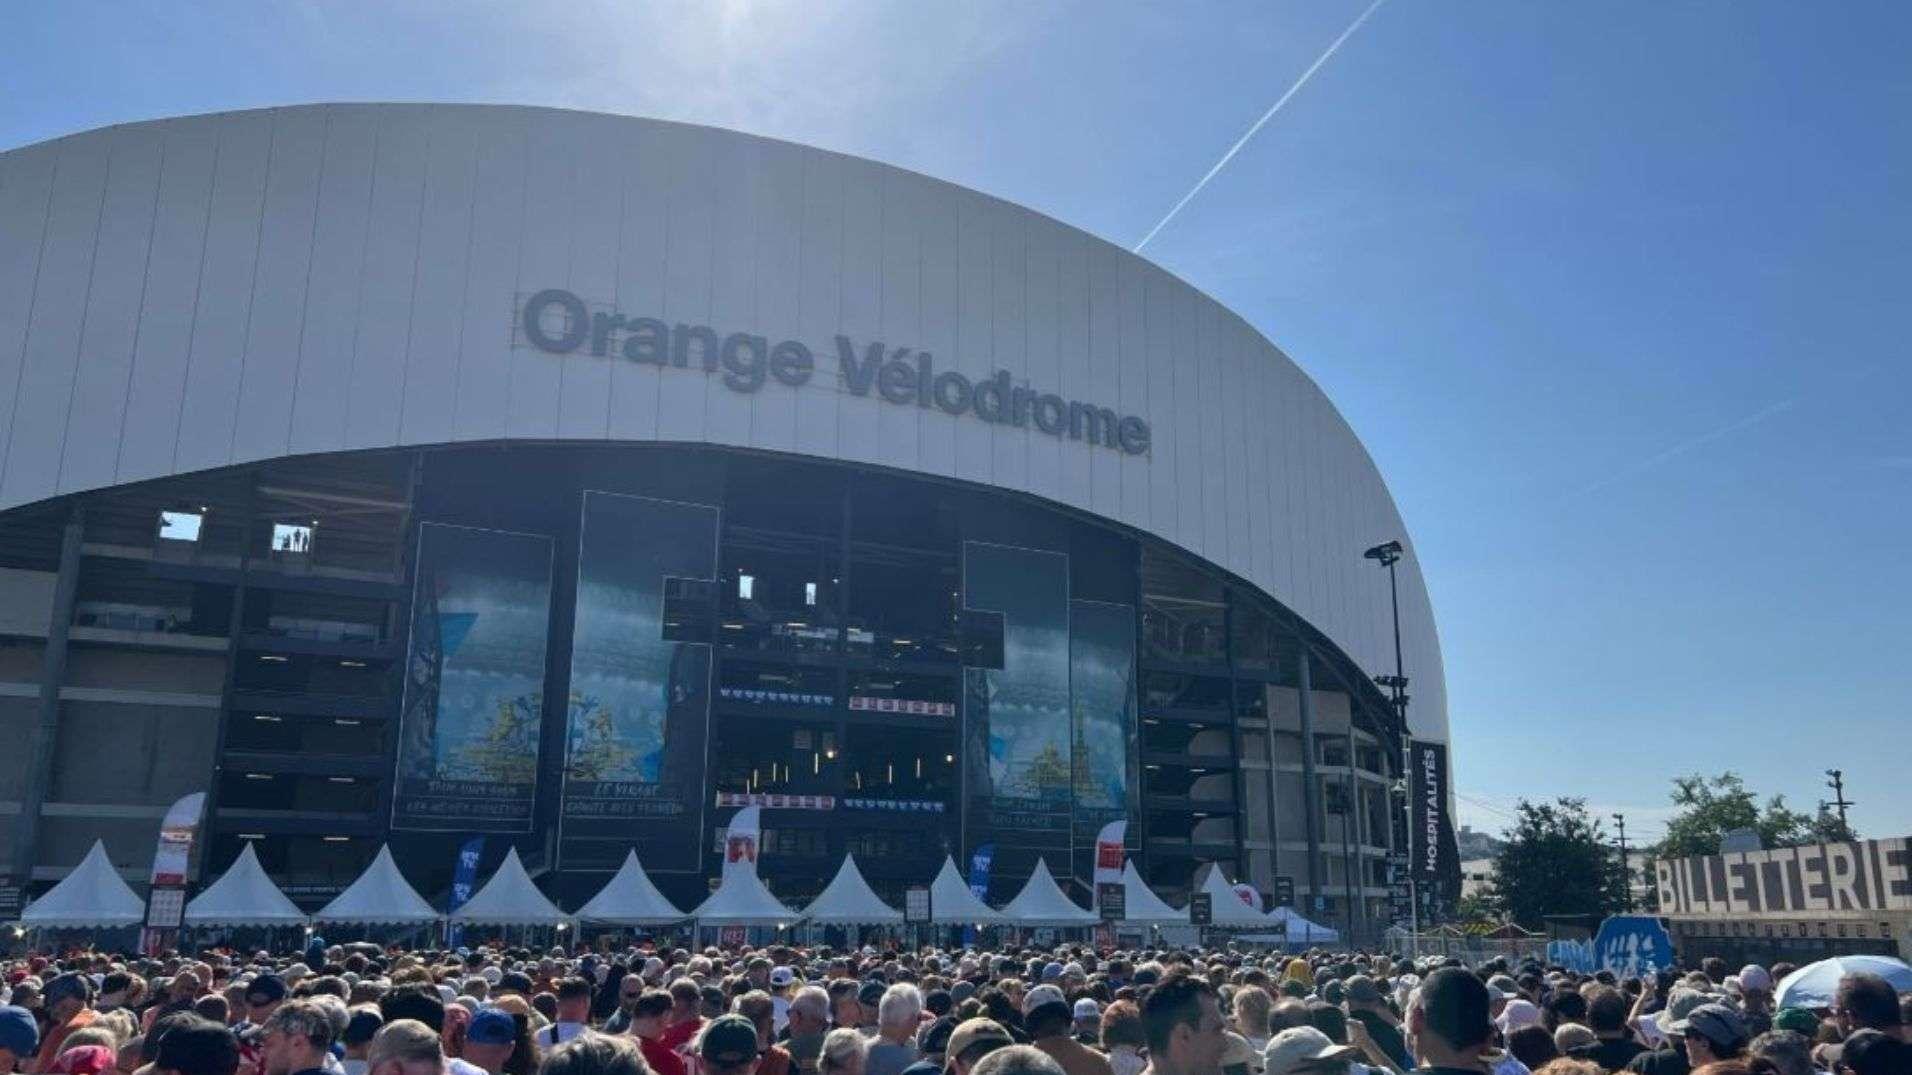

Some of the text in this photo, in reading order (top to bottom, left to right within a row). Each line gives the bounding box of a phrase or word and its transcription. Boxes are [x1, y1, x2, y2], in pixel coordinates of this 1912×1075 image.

[523, 288, 1152, 458] Orange Vélodrome
[1423, 749, 1437, 872] HOSPITALITÉS
[1656, 837, 1912, 914] BILLETTERIE
